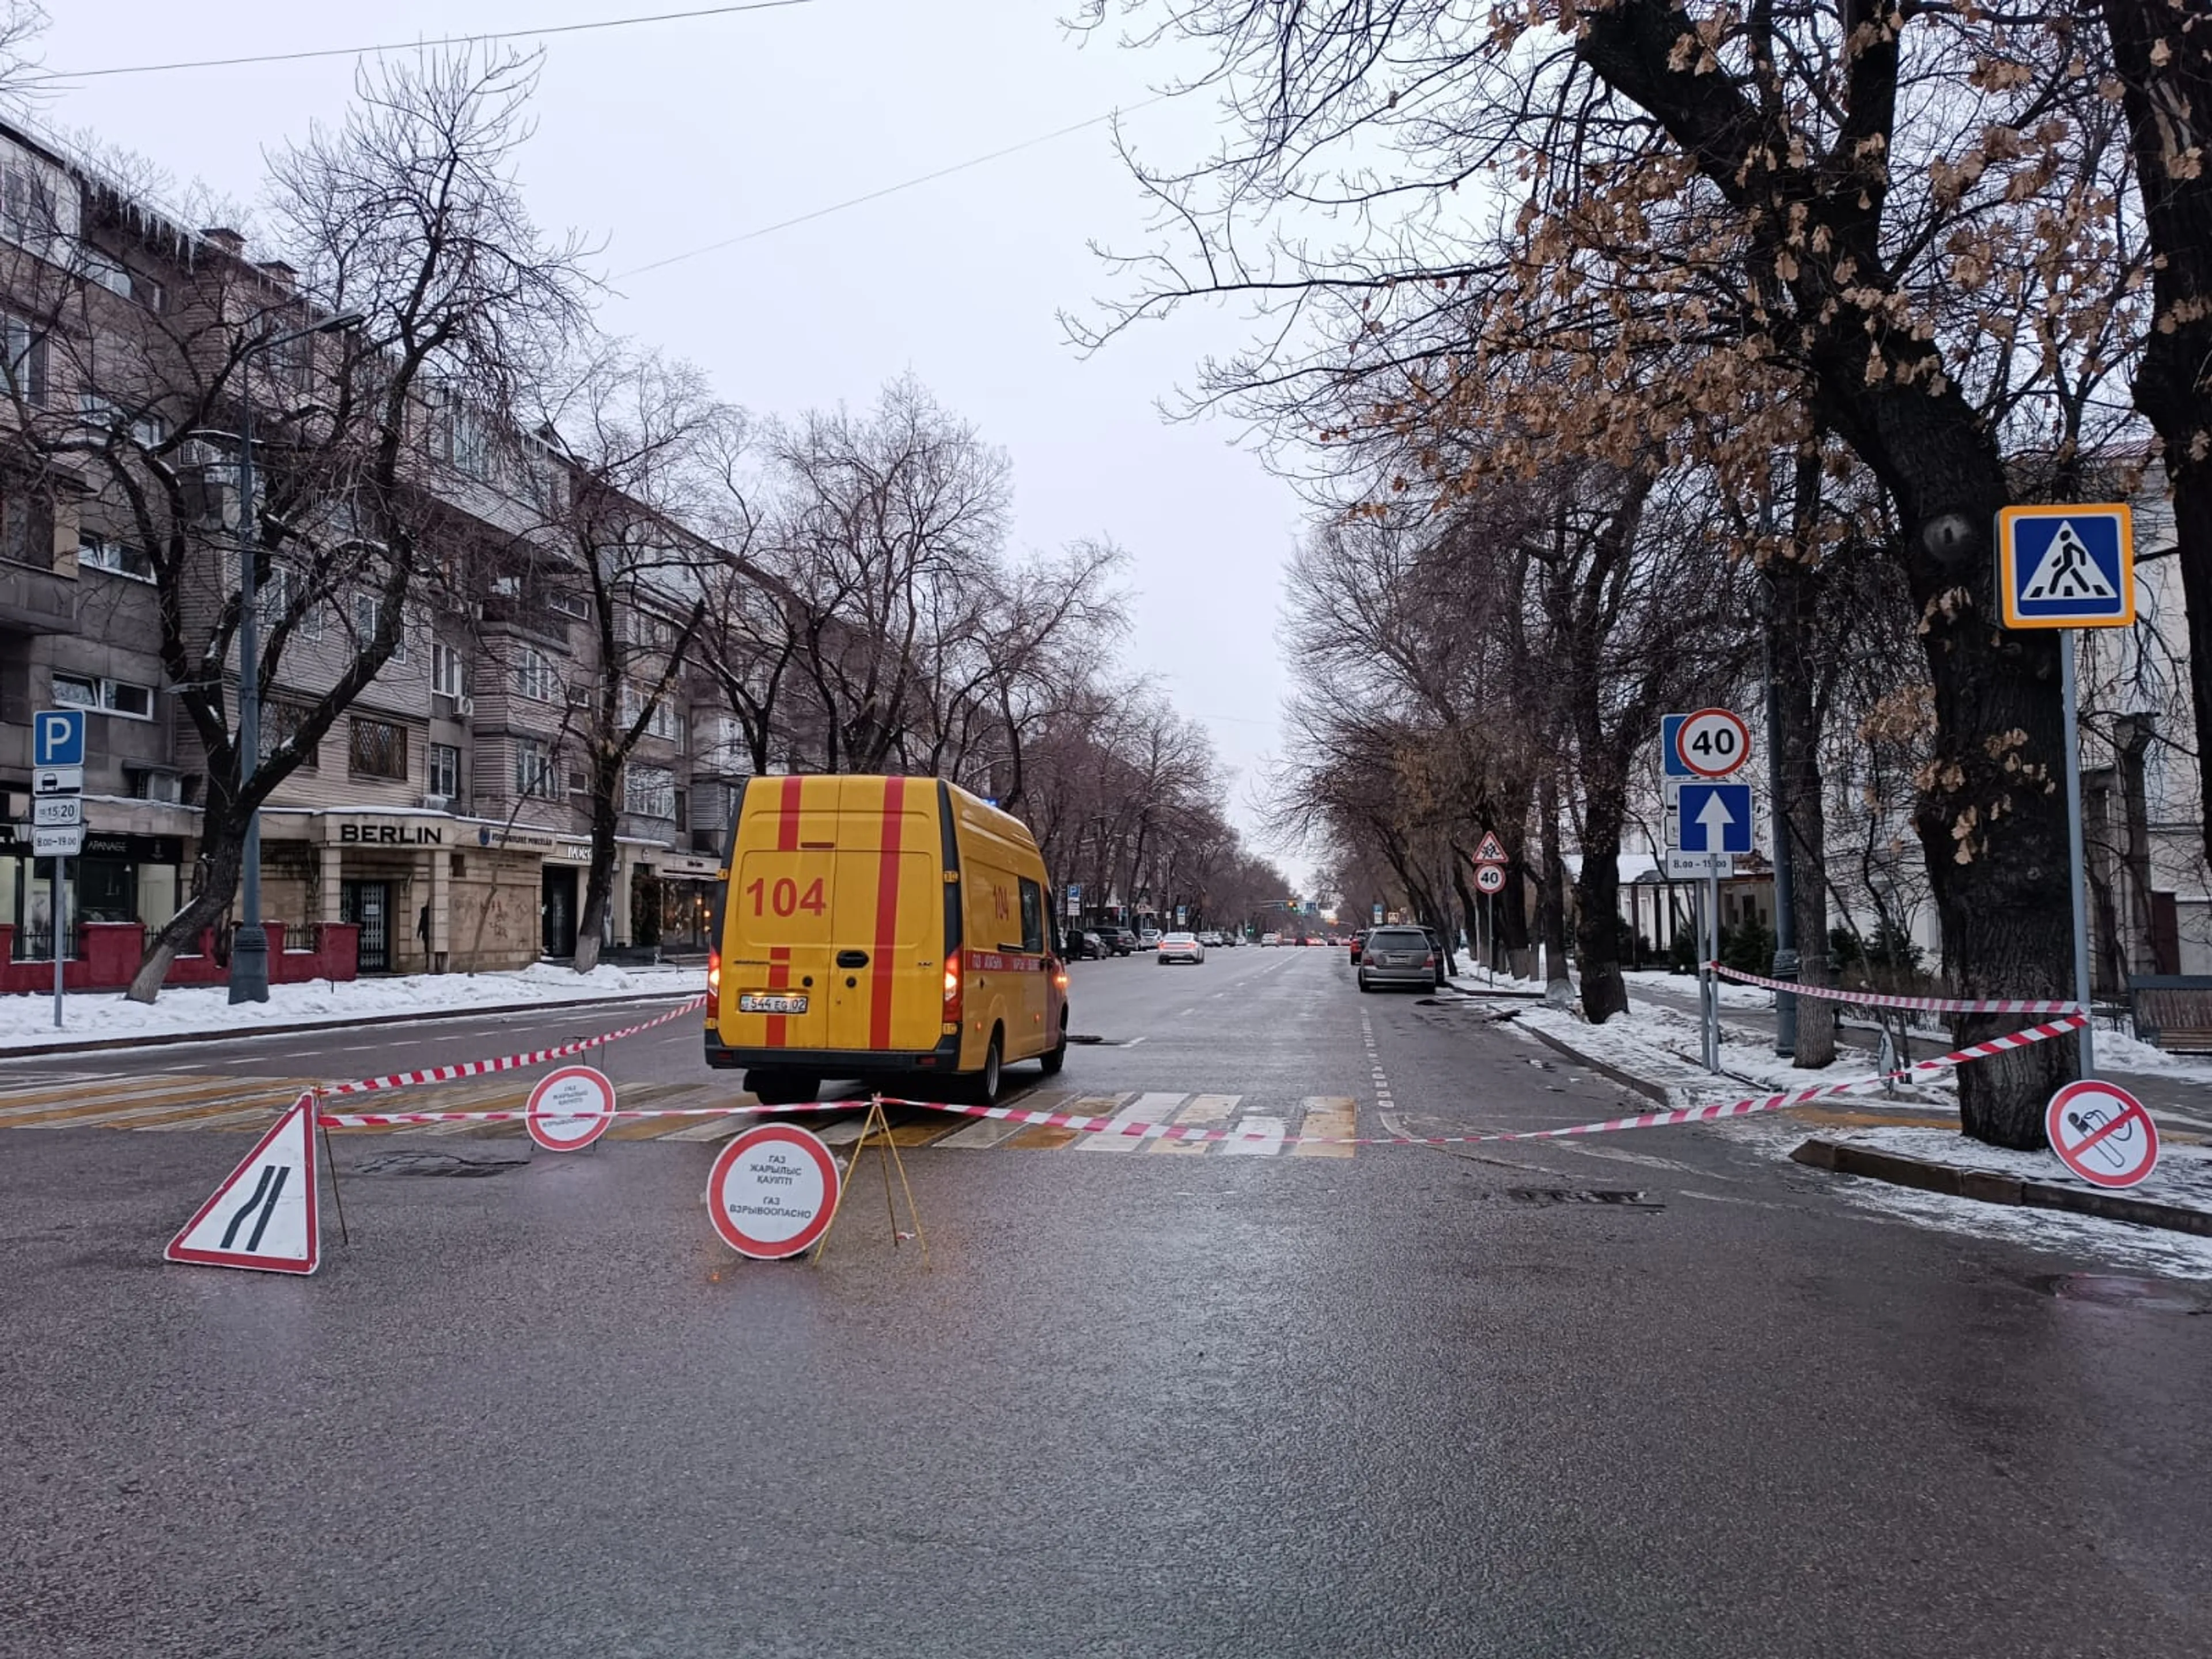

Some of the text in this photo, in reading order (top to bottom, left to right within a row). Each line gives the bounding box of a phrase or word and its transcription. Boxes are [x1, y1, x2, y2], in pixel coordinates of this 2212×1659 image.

[46, 718, 71, 760] P
[1692, 728, 1735, 756] 40
[48, 807, 58, 817] 15
[60, 805, 74, 818] 20
[341, 824, 442, 844] BERLIN
[1480, 872, 1498, 884] 40
[747, 877, 827, 917] 104
[993, 884, 1009, 921] 104
[751, 998, 771, 1009] 544
[792, 999, 805, 1010] 02
[768, 1155, 786, 1164] ГАЗ
[763, 1196, 781, 1205] ГАЗ
[730, 1204, 811, 1218] ВЗРЫВООПАСНО
